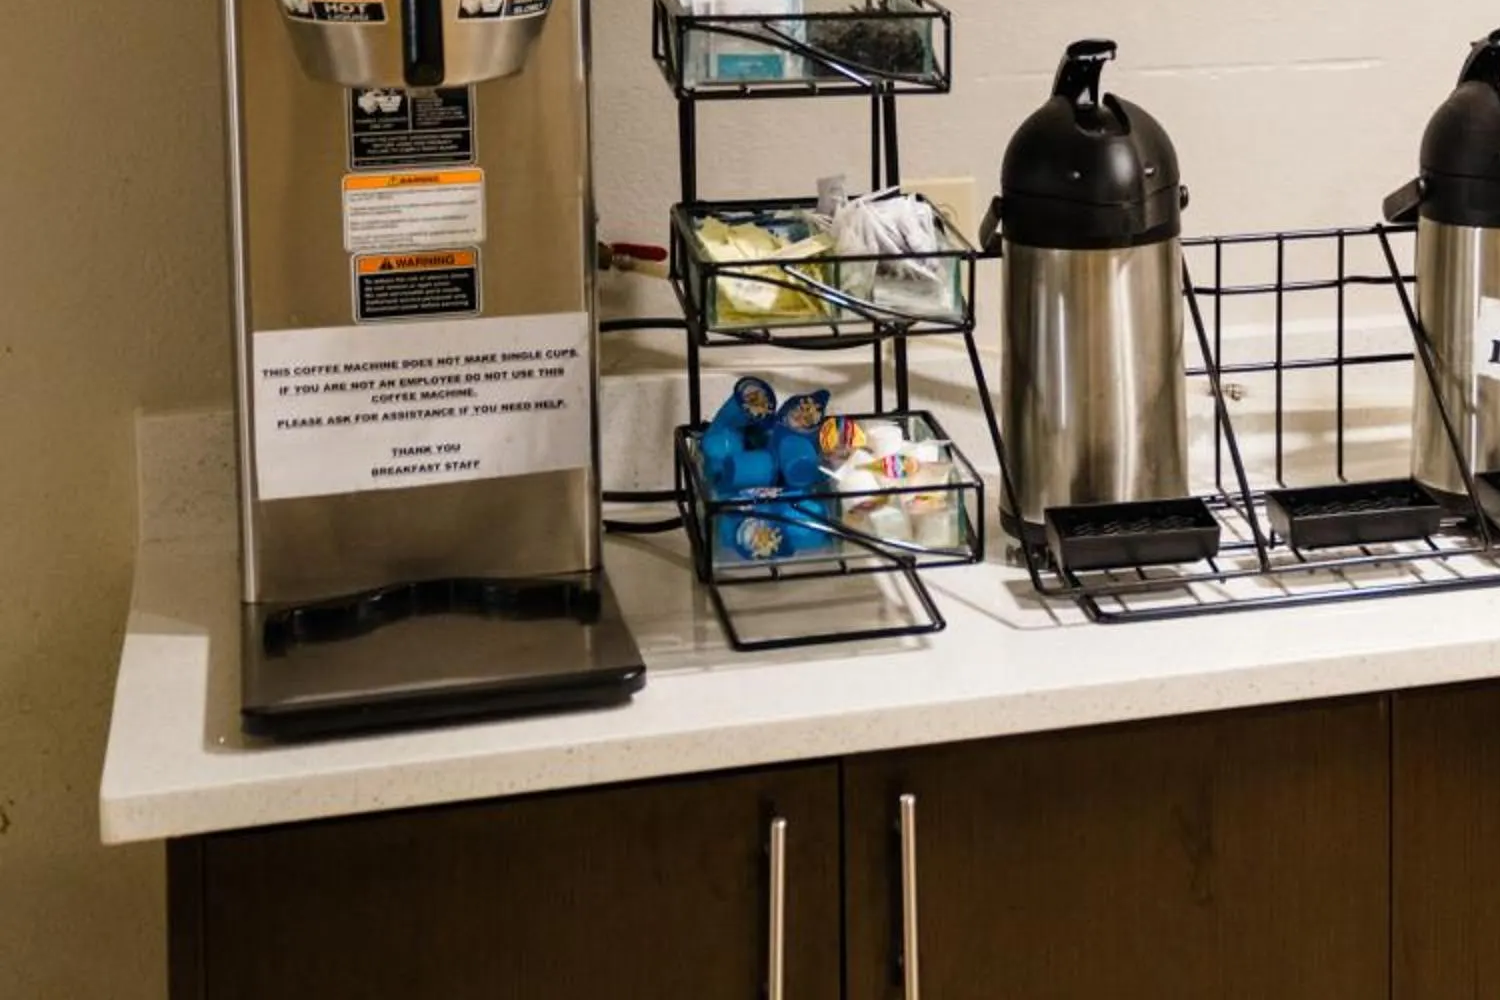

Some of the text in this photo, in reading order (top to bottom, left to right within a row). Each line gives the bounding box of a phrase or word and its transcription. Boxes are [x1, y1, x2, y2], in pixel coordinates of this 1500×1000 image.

[263, 368, 291, 377] THIS
[293, 364, 339, 376] COFFEE
[343, 360, 398, 373] MACHINE
[402, 357, 433, 369] DOES
[437, 355, 460, 366] NOT
[464, 353, 497, 363] MAKE
[501, 350, 542, 362] SINGLE
[279, 367, 565, 396] IF YOU ARE NOT AN EMPLOYEE DO NOT USE THIS
[371, 391, 417, 403] COFFEE
[277, 417, 323, 429] PLEASE
[327, 415, 351, 425] ASK
[355, 413, 379, 423] FOR
[381, 407, 455, 421] ASSISTANCE
[459, 406, 469, 416] IF
[473, 404, 497, 414] YOU
[501, 401, 532, 411] NEED
[391, 443, 461, 456] THANK YOU
[371, 459, 481, 477] BREAKFAST STAFF
